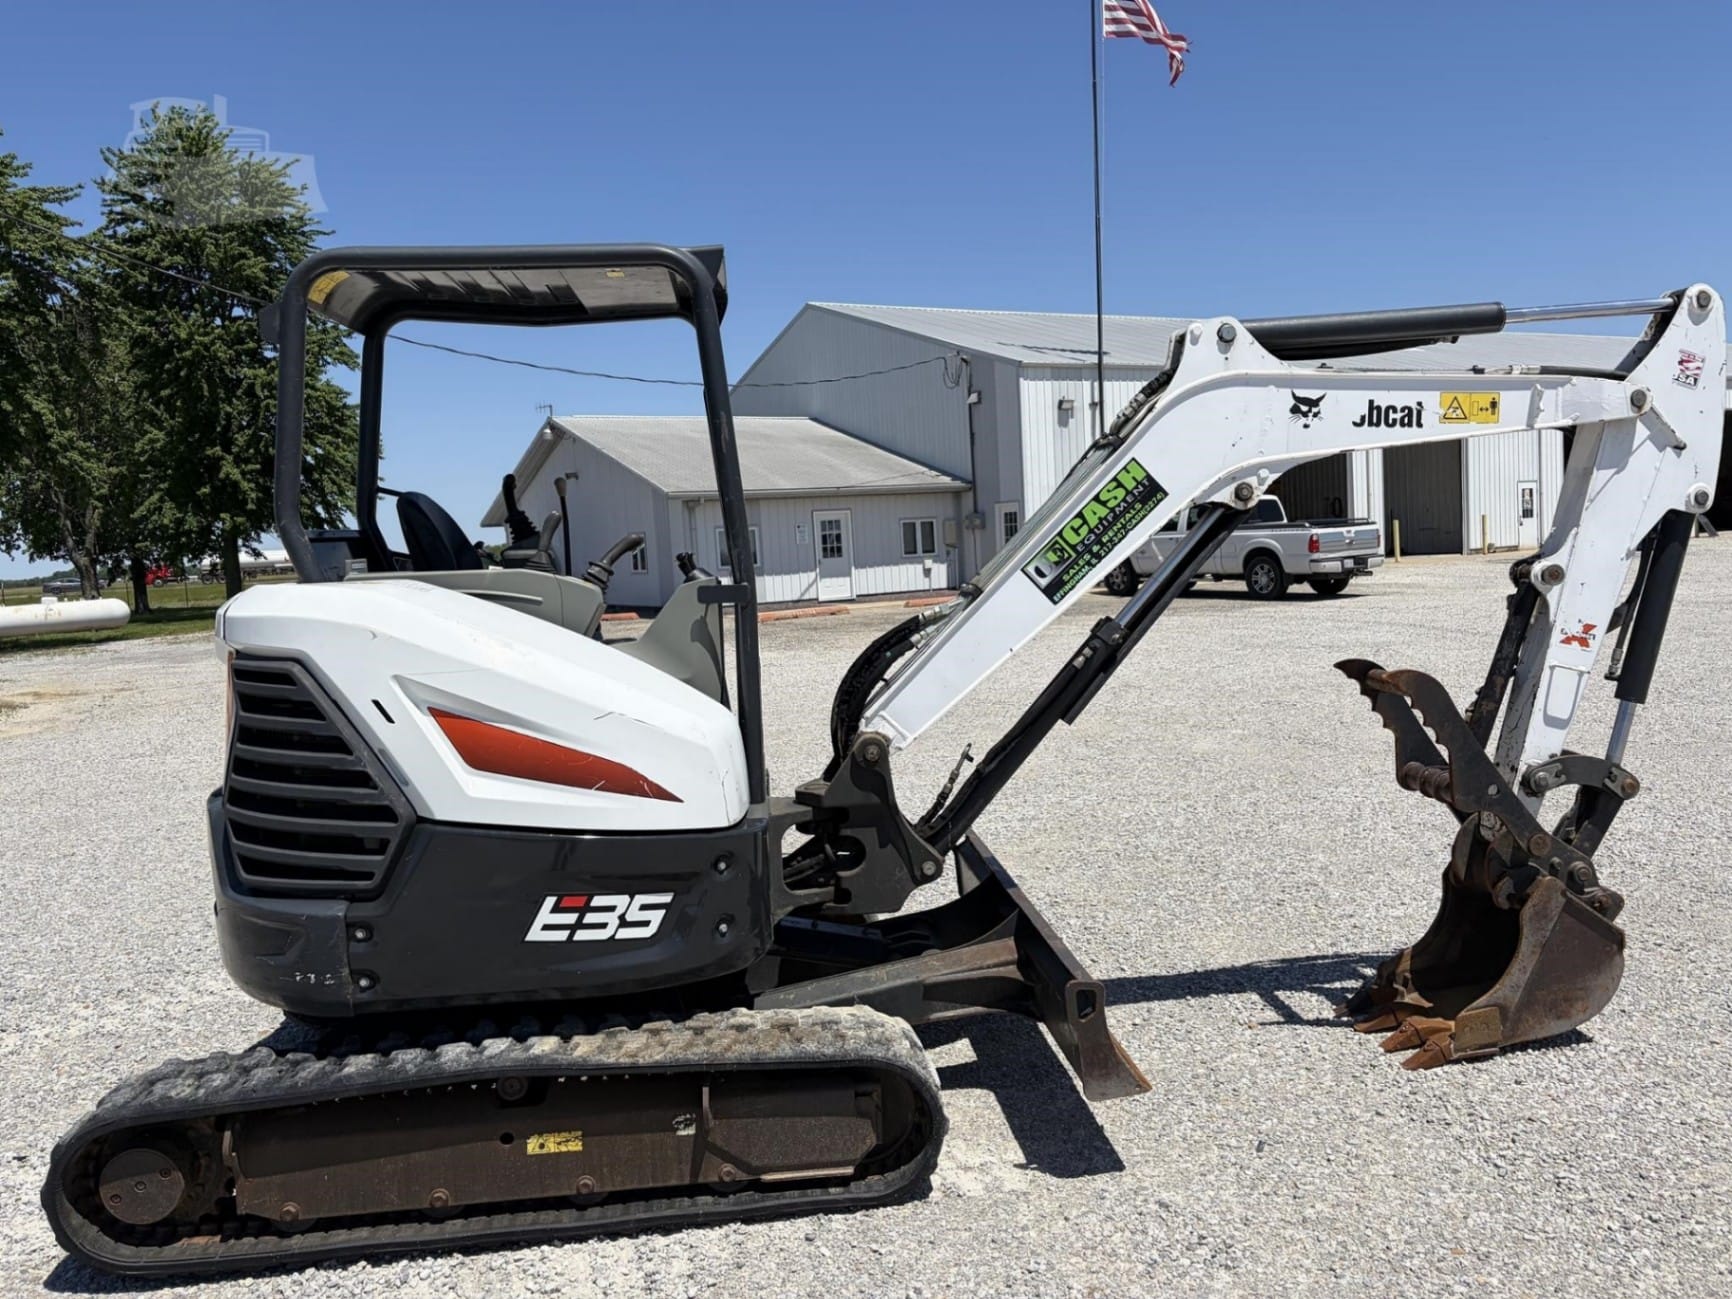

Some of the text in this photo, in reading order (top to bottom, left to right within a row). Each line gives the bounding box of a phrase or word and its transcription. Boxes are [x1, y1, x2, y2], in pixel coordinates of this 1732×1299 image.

[1062, 460, 1147, 546] CASH
[1077, 478, 1150, 552] EQUIPMENT
[1062, 552, 1091, 582] SALES
[1101, 502, 1143, 543] RENTALS
[524, 892, 675, 942] E35
